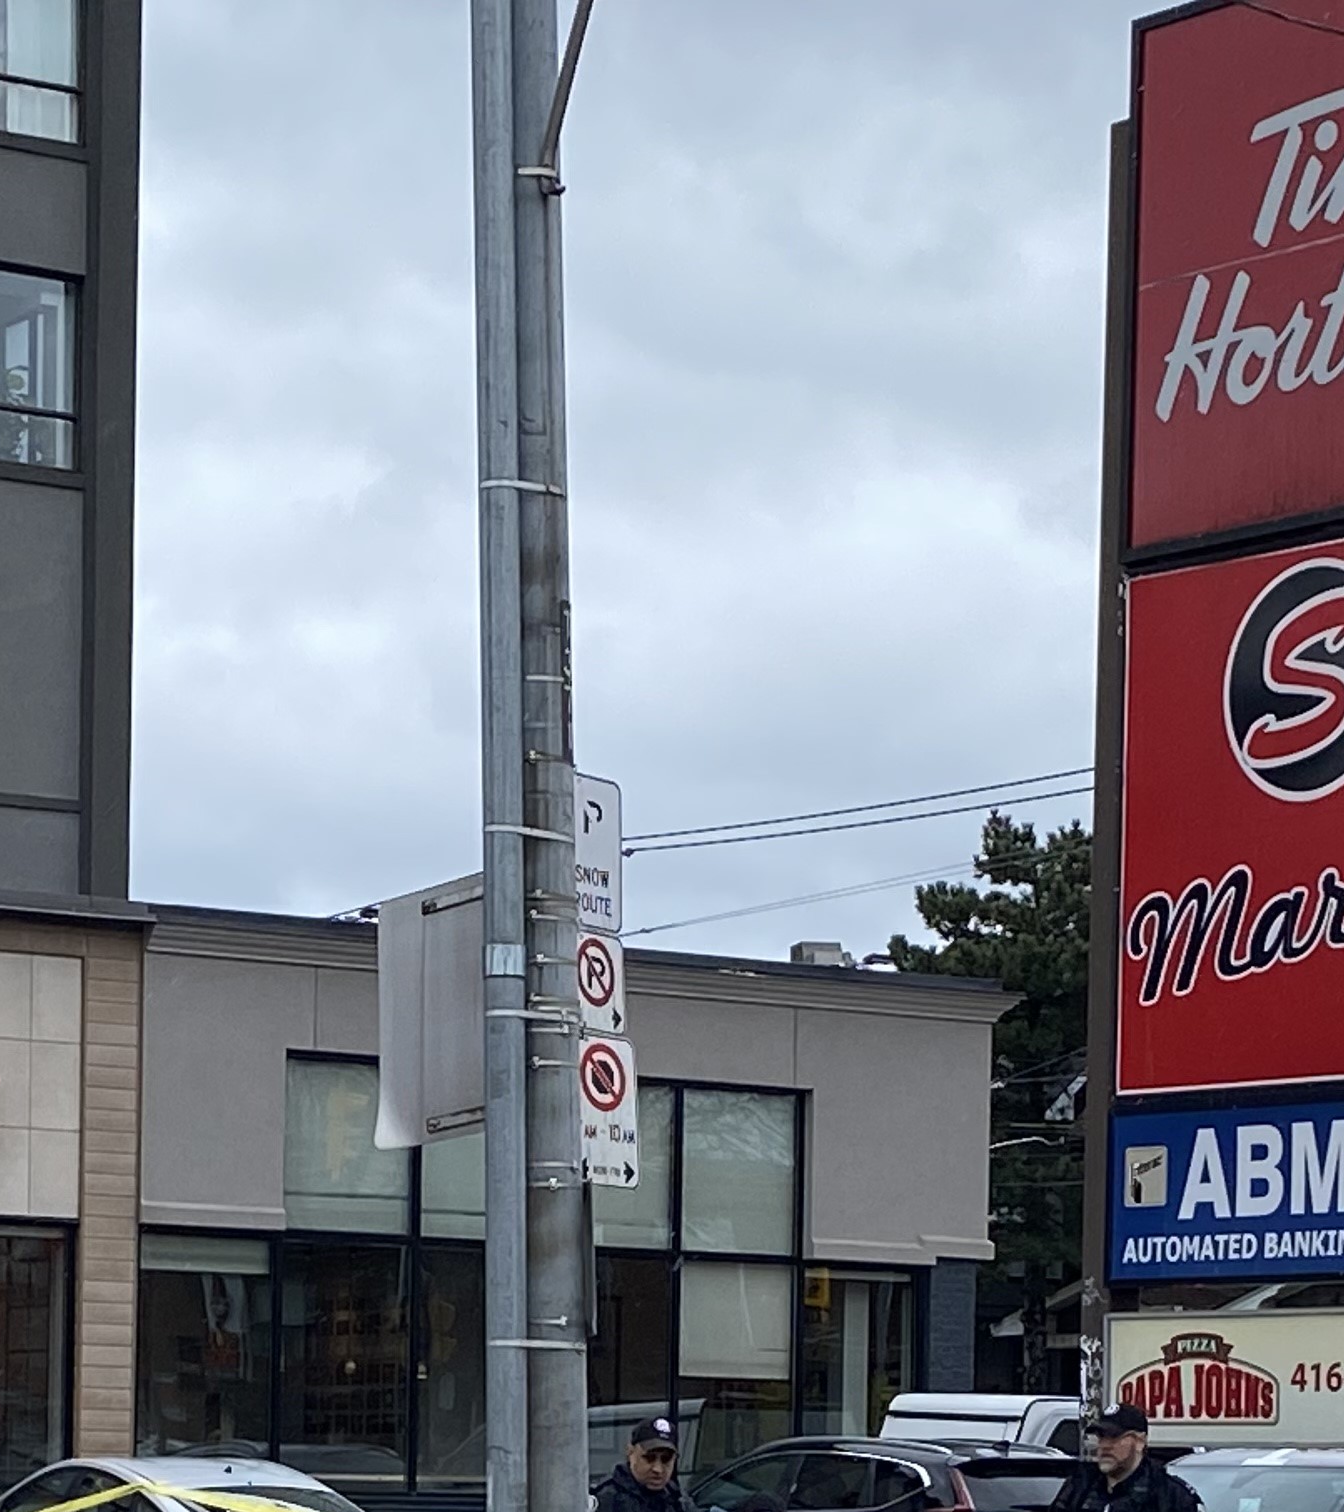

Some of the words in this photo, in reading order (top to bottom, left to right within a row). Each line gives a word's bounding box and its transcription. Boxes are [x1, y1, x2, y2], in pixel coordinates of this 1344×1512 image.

[575, 863, 609, 889] SNOW
[1122, 1232, 1258, 1264] AUTOMATED
[1176, 1338, 1218, 1354] PIZZA
[1121, 1364, 1185, 1419] PAPA
